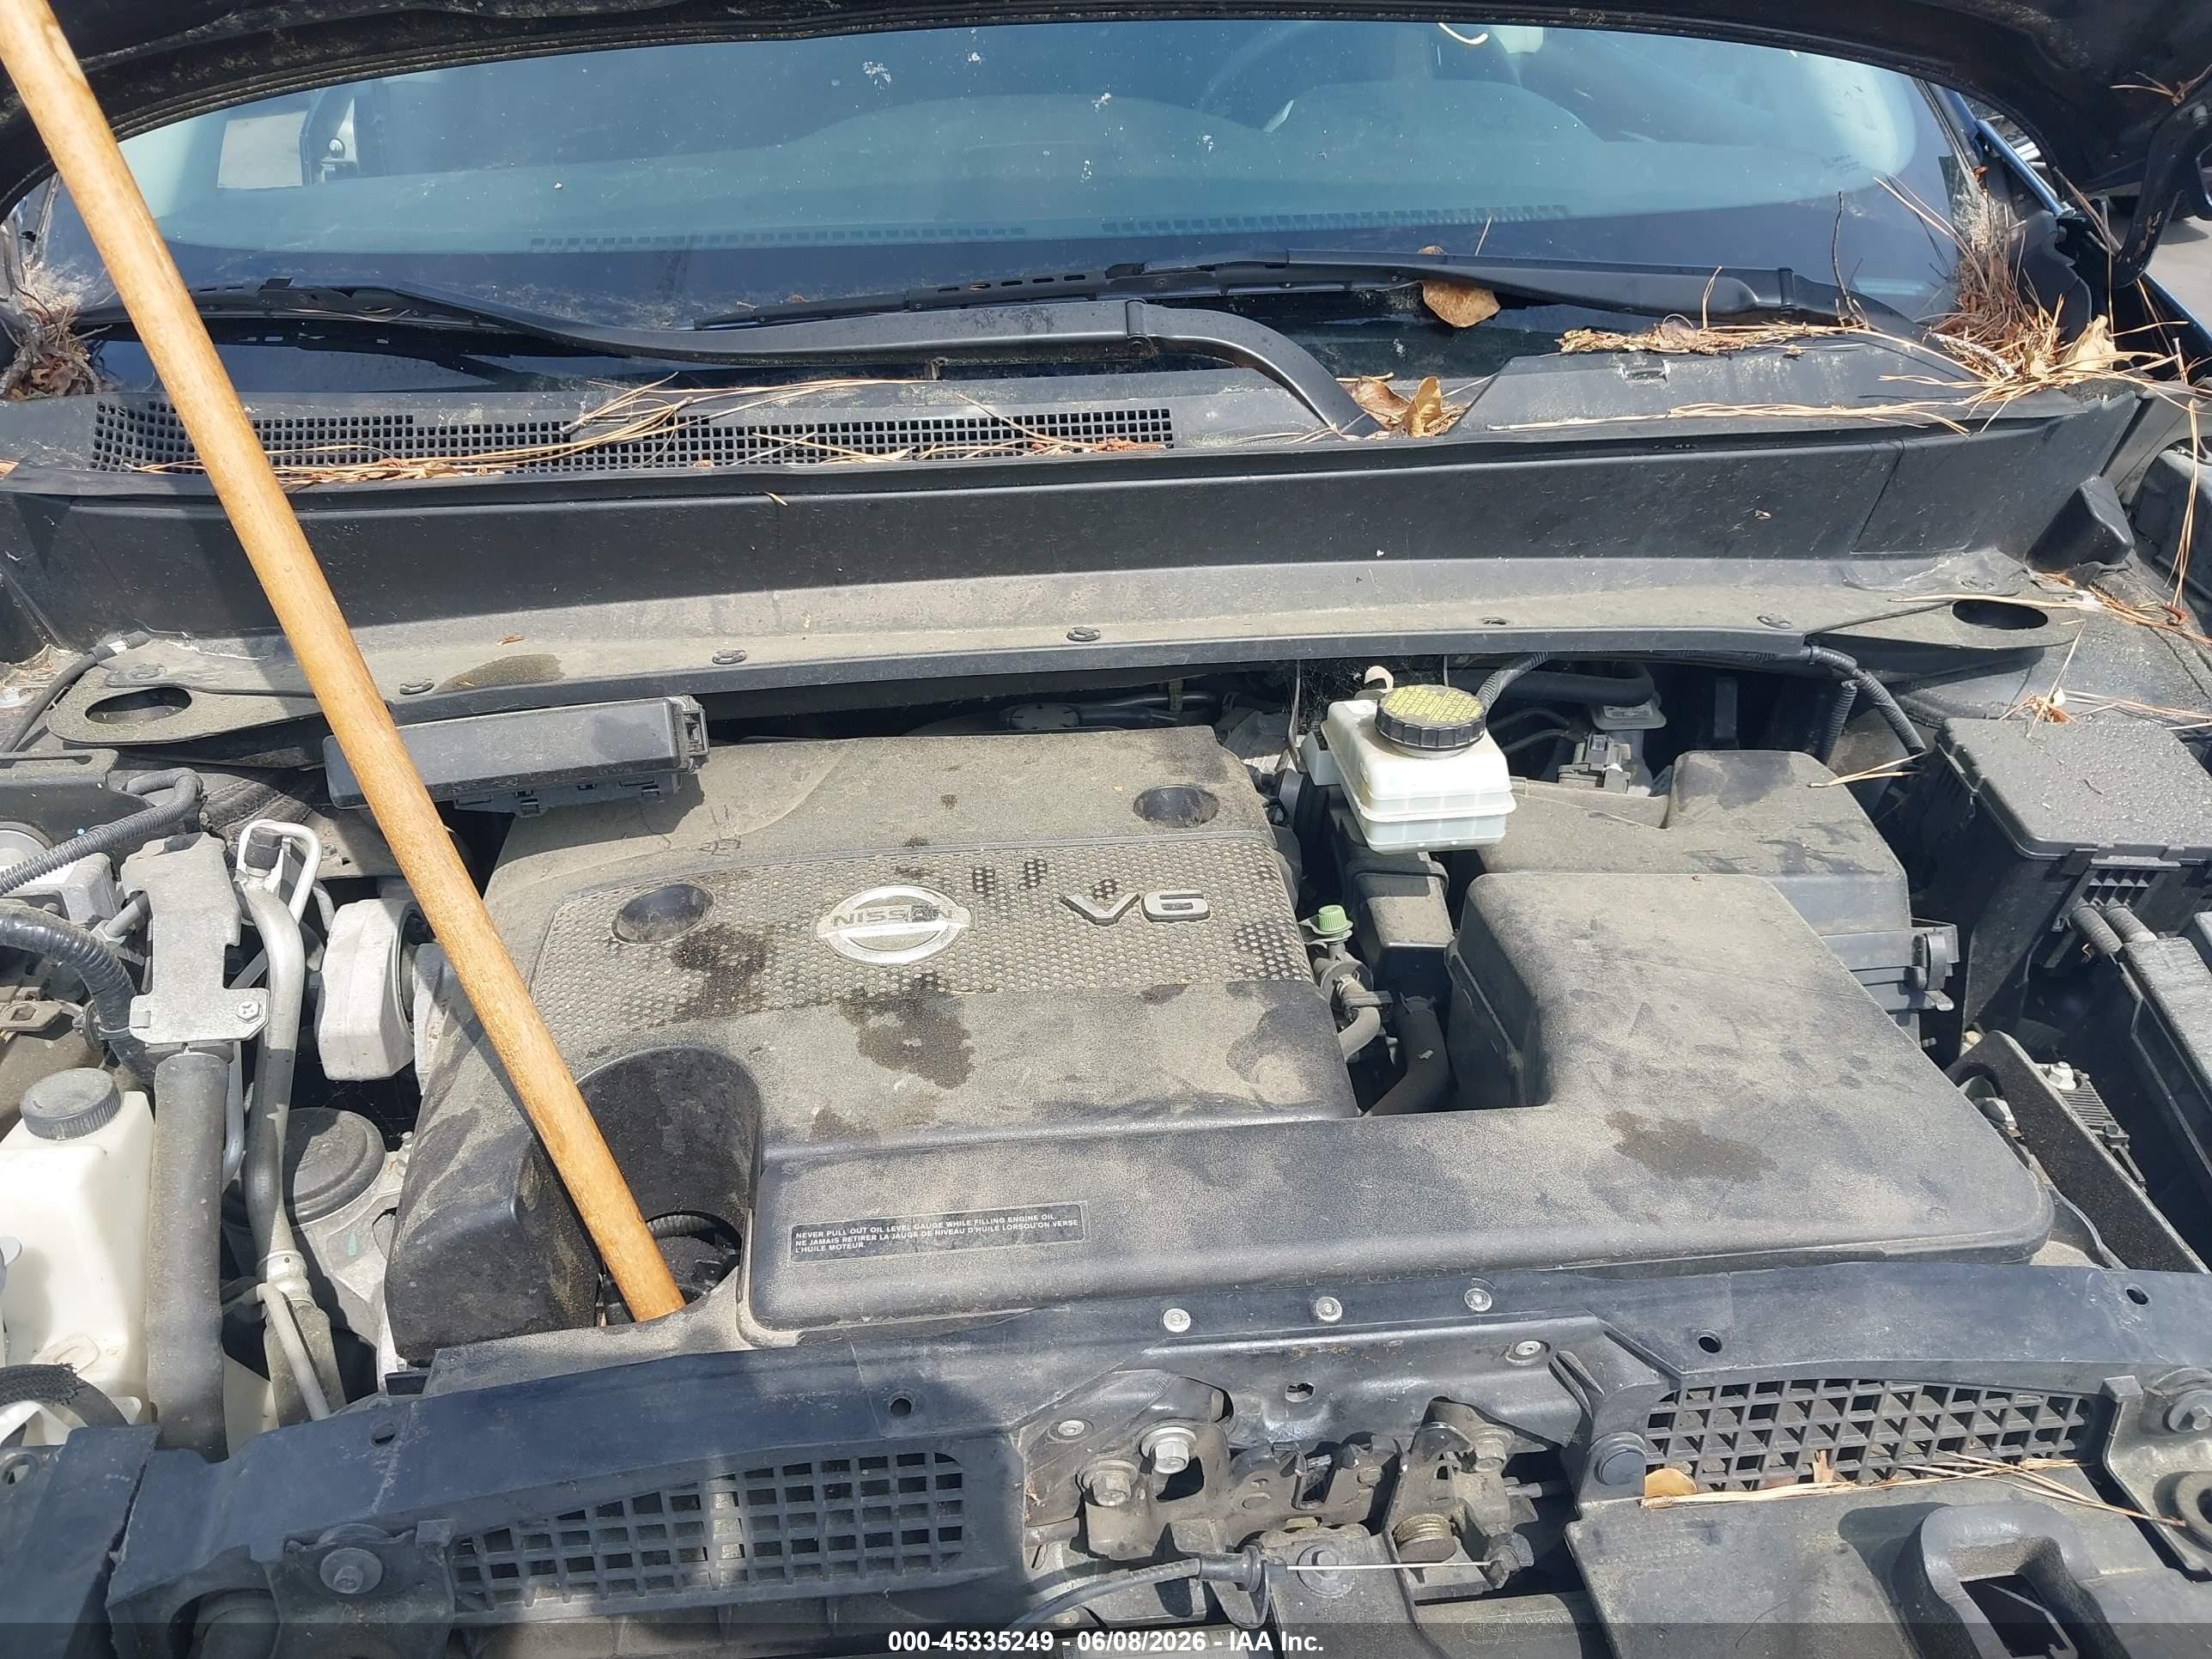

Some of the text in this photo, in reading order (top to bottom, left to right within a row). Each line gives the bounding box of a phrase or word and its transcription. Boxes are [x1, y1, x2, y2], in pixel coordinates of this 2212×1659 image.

[833, 905, 953, 927] NISSAN
[1061, 890, 1211, 927] V6
[809, 1237, 840, 1245] JAMAIS
[842, 1234, 878, 1243] RETIRER
[890, 1231, 919, 1239] JAUGE
[934, 1227, 965, 1236] NIVEAU
[967, 1224, 1000, 1234] D'HUILE
[1002, 1221, 1050, 1231] LORSQU'ON
[1052, 1218, 1079, 1228] VERSE
[946, 1219, 973, 1228] WHILE
[975, 1217, 1006, 1225] FILLING
[1007, 1214, 1039, 1223] ENGINE
[795, 1242, 866, 1254] L'HUILE MOTEUR.
